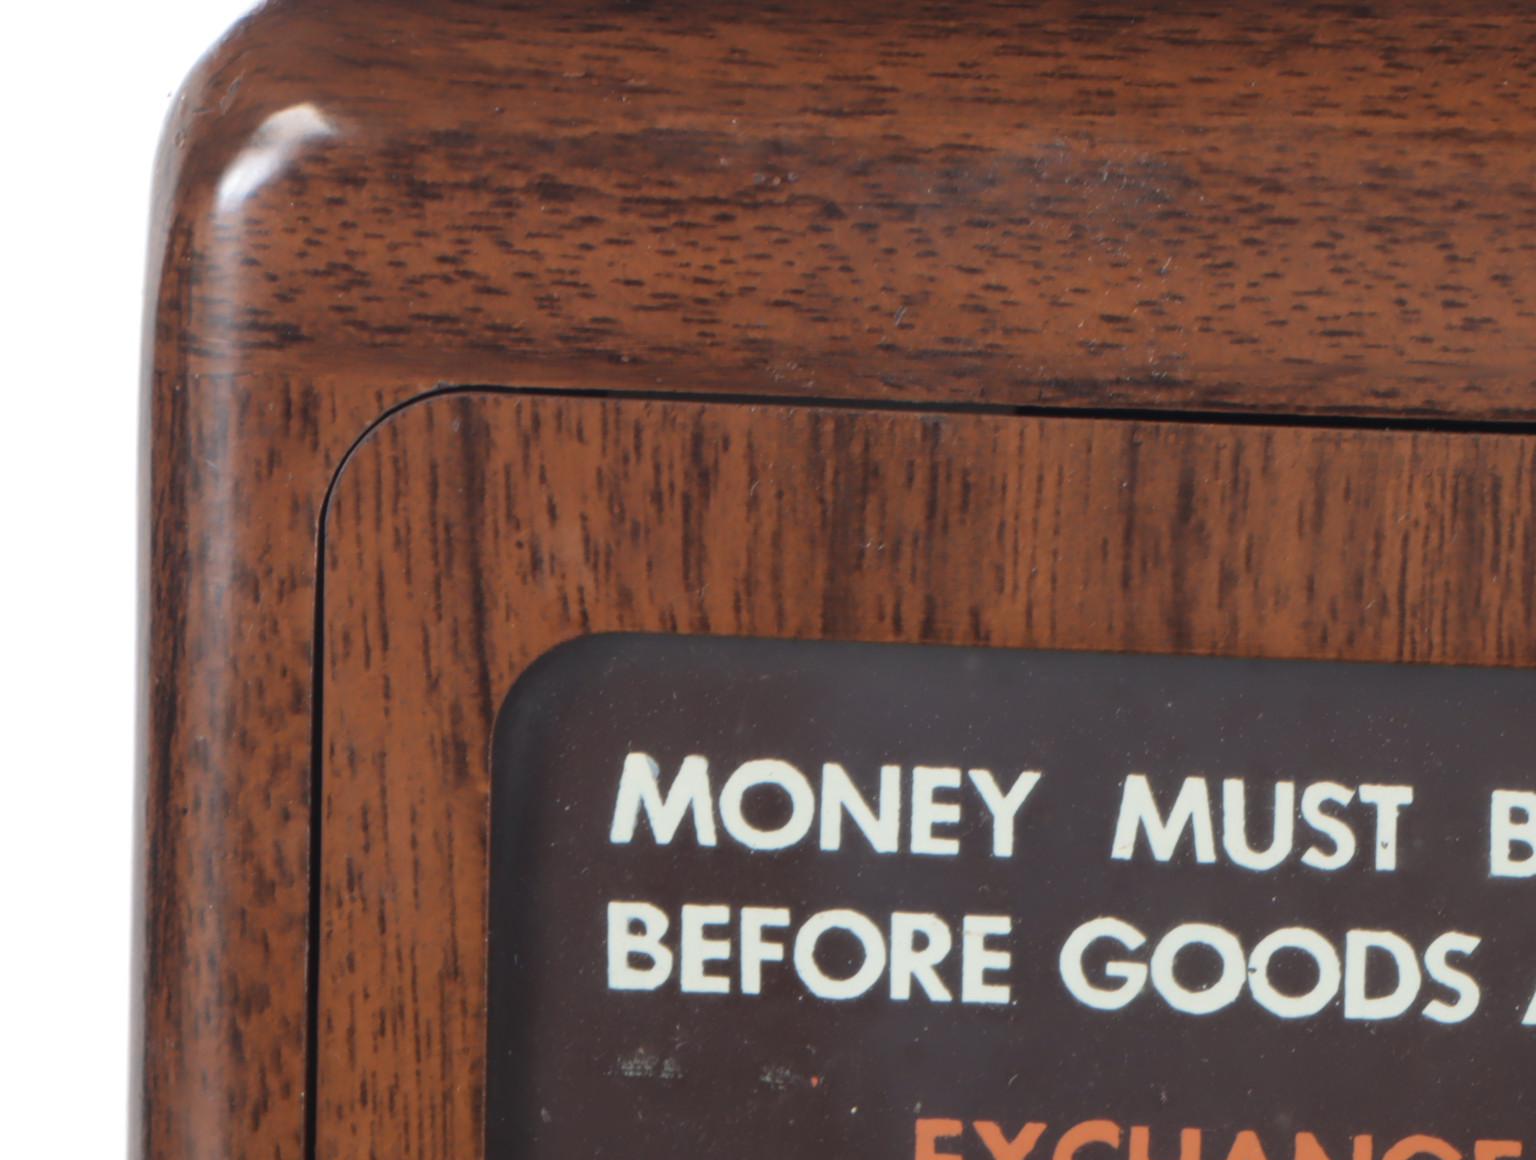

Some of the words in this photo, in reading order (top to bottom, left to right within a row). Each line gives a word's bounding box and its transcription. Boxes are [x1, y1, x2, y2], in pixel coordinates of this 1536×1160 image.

[609, 751, 1042, 858] MONEY
[1110, 773, 1414, 872] MUST
[606, 900, 1013, 1005] BEFORE
[1059, 915, 1482, 1025] GOODS
